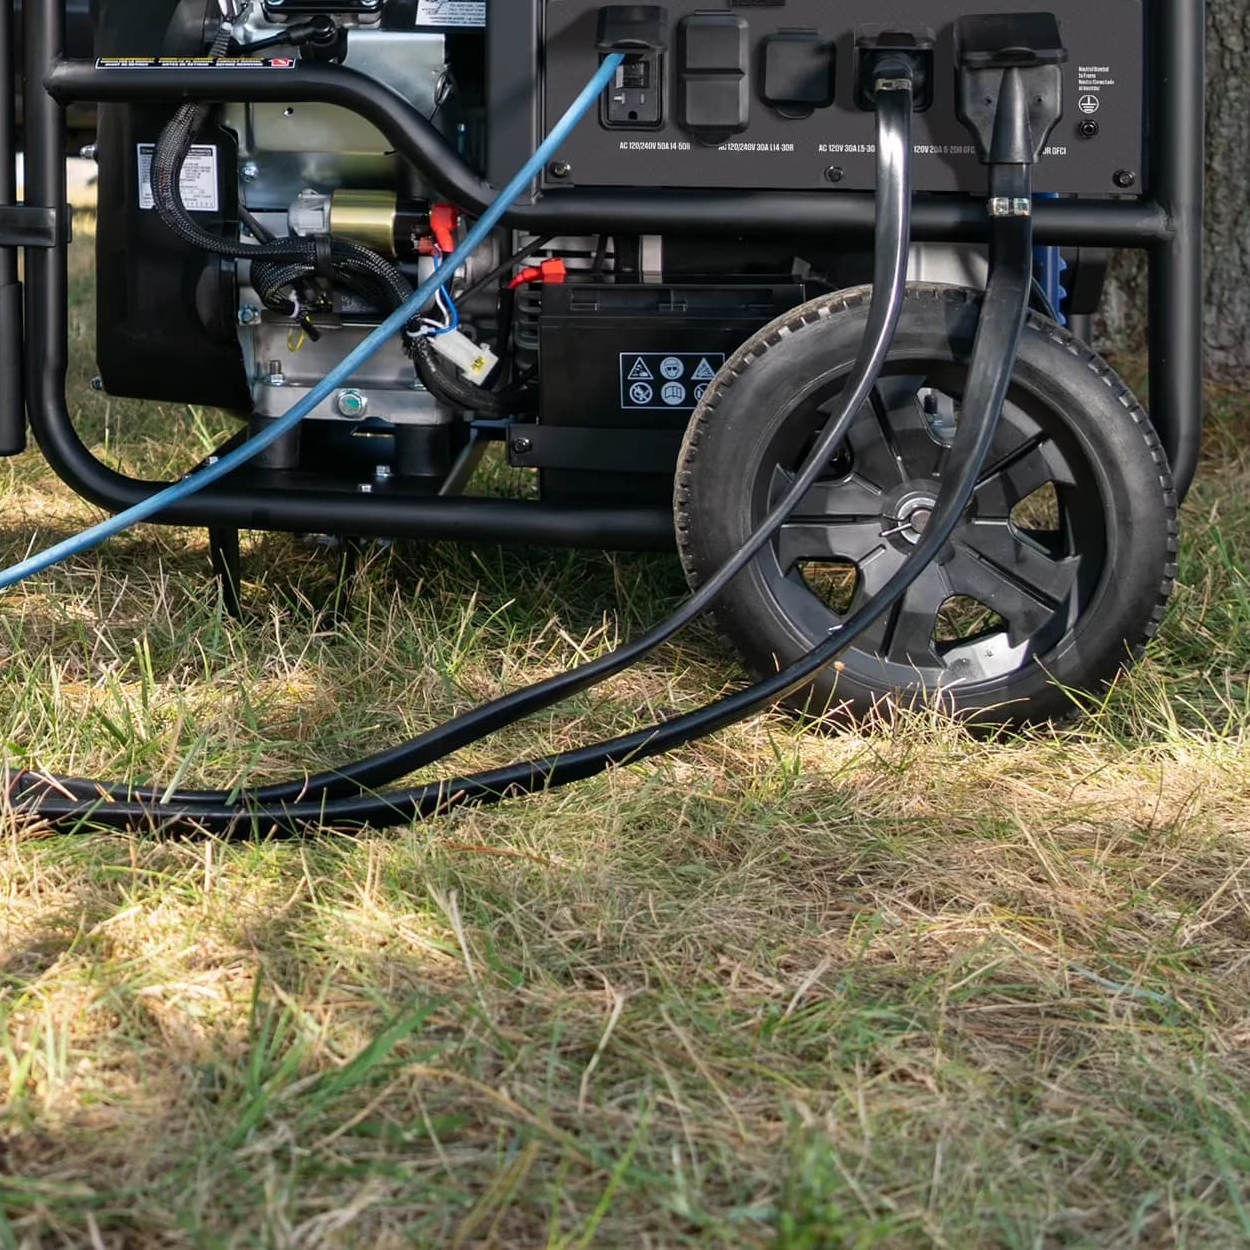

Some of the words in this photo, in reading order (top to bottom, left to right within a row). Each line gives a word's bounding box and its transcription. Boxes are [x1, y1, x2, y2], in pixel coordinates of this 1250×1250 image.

[620, 141, 627, 150] AC
[629, 141, 656, 150] 120/240V
[657, 141, 669, 150] 50A
[728, 142, 756, 152] 120/240V
[756, 143, 769, 151] 30A
[819, 143, 827, 152] AC
[829, 144, 843, 152] 120V
[857, 144, 876, 152] L5-30
